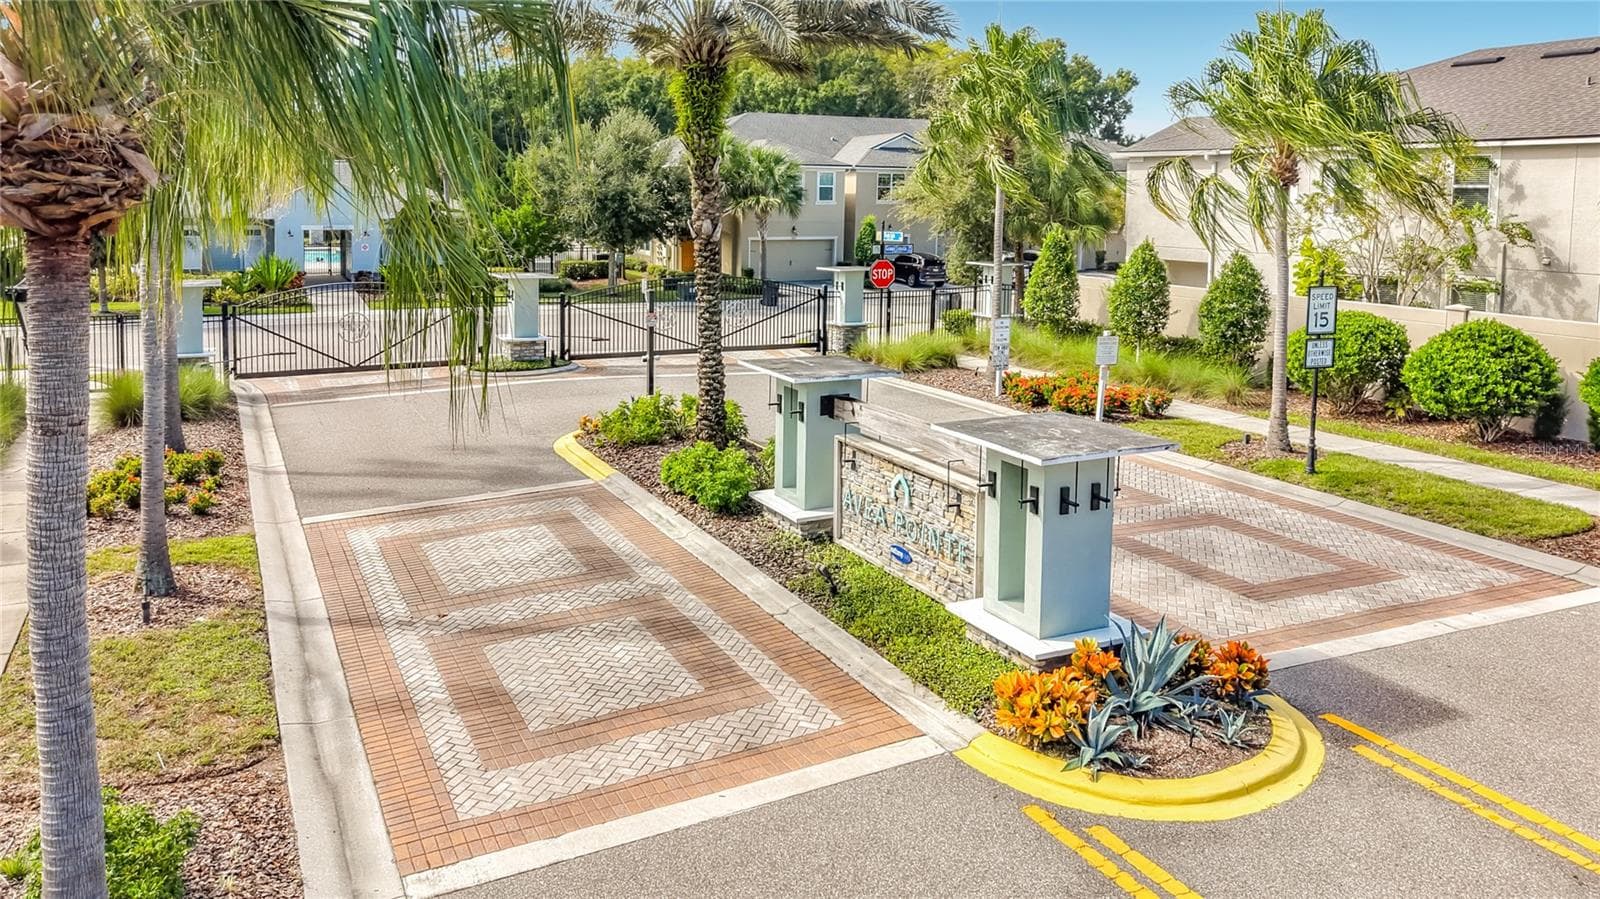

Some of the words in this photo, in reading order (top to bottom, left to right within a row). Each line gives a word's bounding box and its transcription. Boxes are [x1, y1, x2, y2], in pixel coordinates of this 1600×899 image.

[872, 268, 893, 280] STOP
[1311, 293, 1334, 301] SPEED
[1313, 302, 1331, 310] LIMIT
[1313, 311, 1329, 328] 15
[843, 488, 889, 528] AVEA
[894, 511, 970, 570] POINTE
